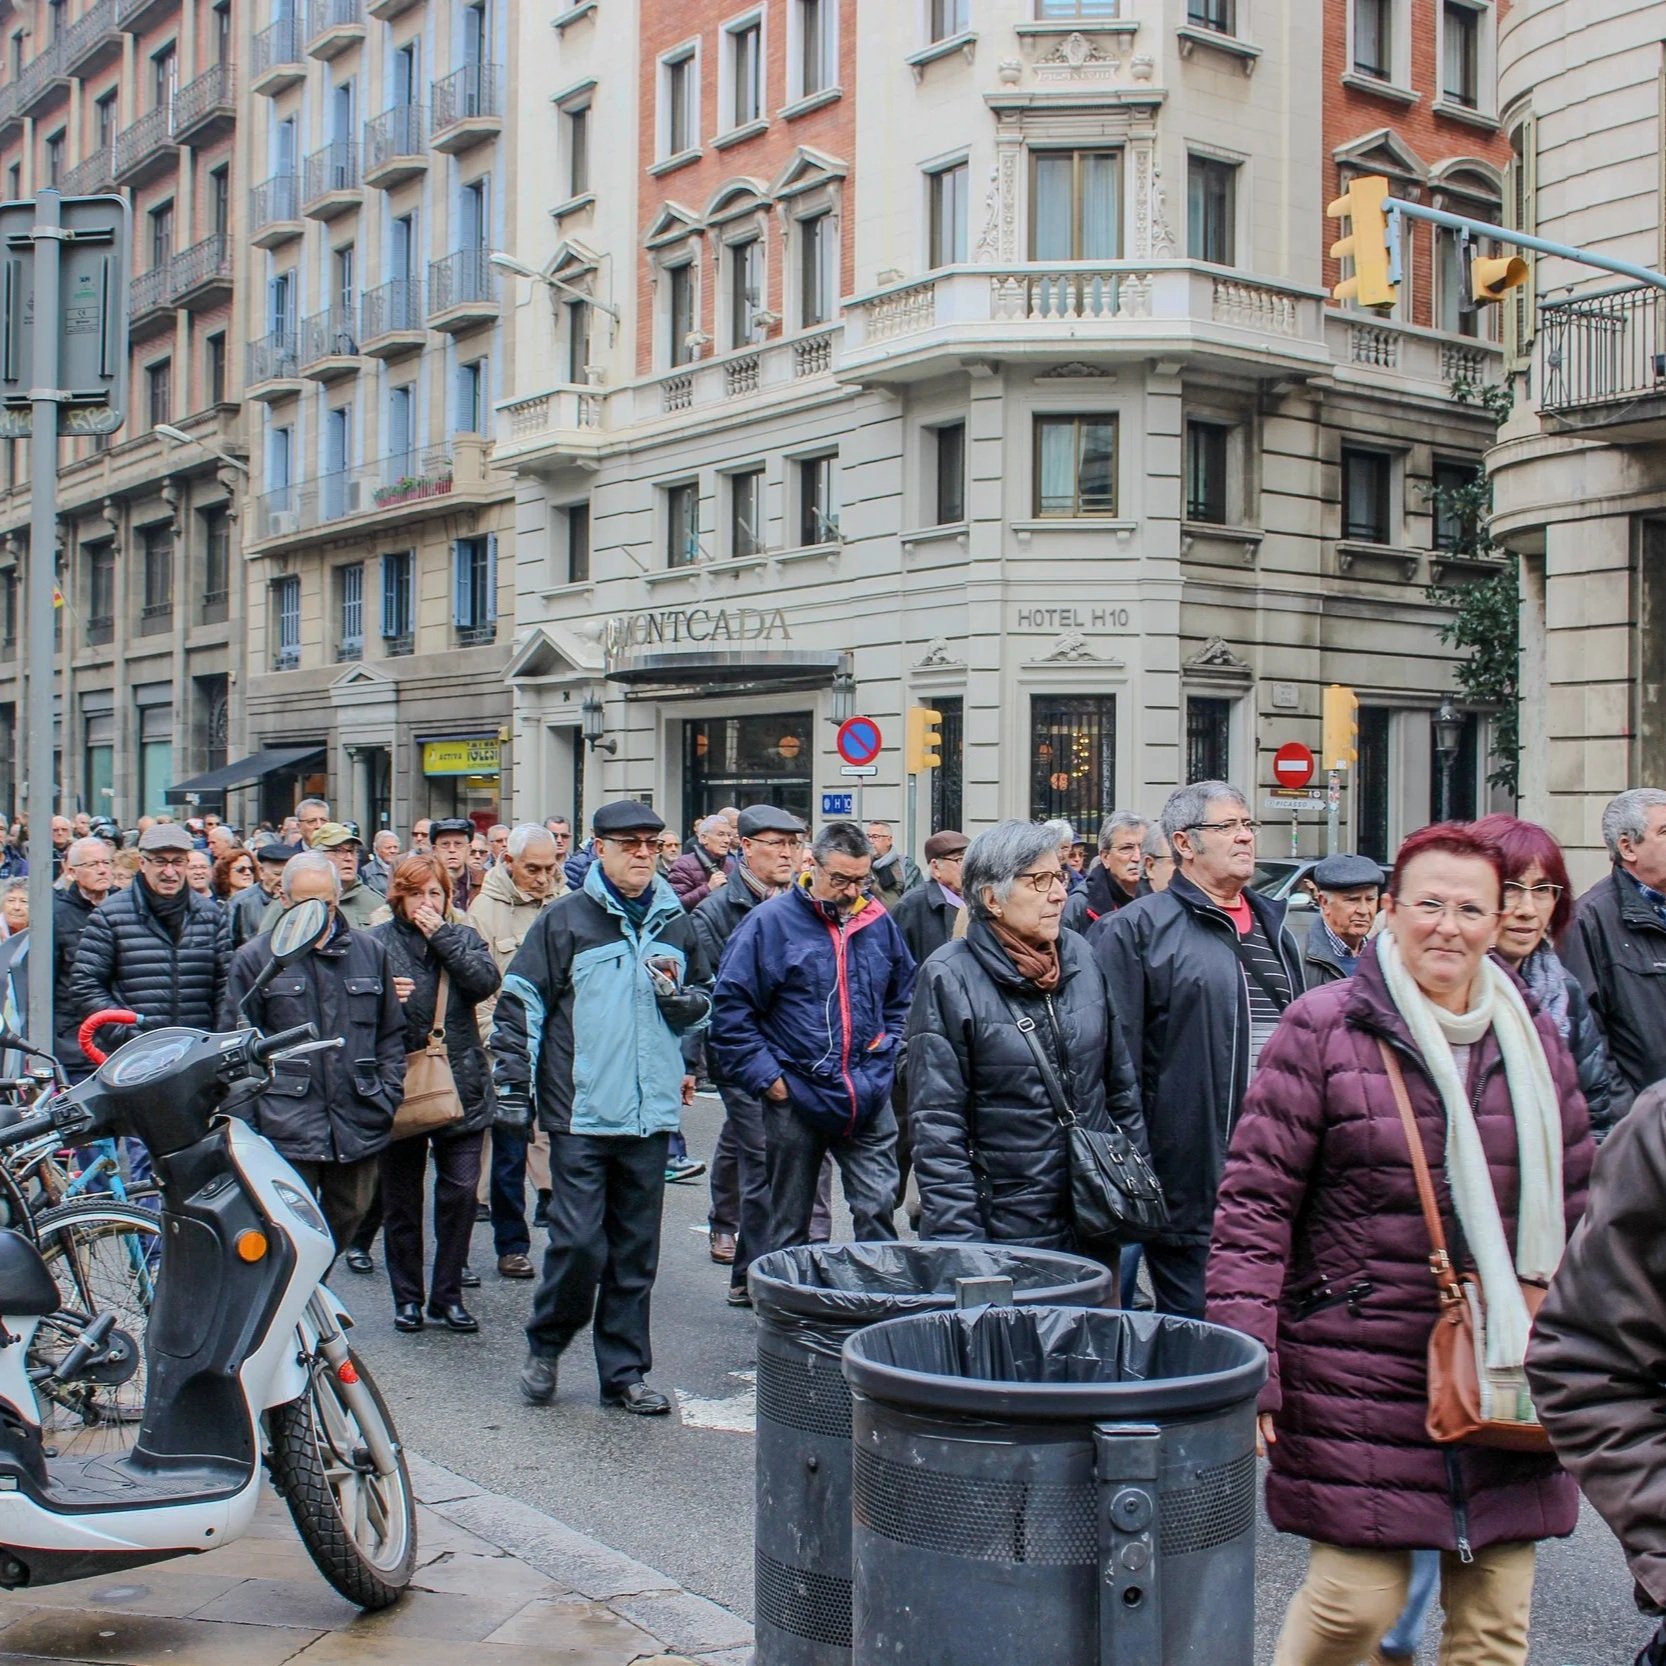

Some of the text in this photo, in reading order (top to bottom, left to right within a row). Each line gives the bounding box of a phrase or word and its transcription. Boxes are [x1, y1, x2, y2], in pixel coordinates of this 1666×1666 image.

[1018, 608, 1129, 627] HOTEL H10
[1275, 800, 1308, 808] PICASSO
